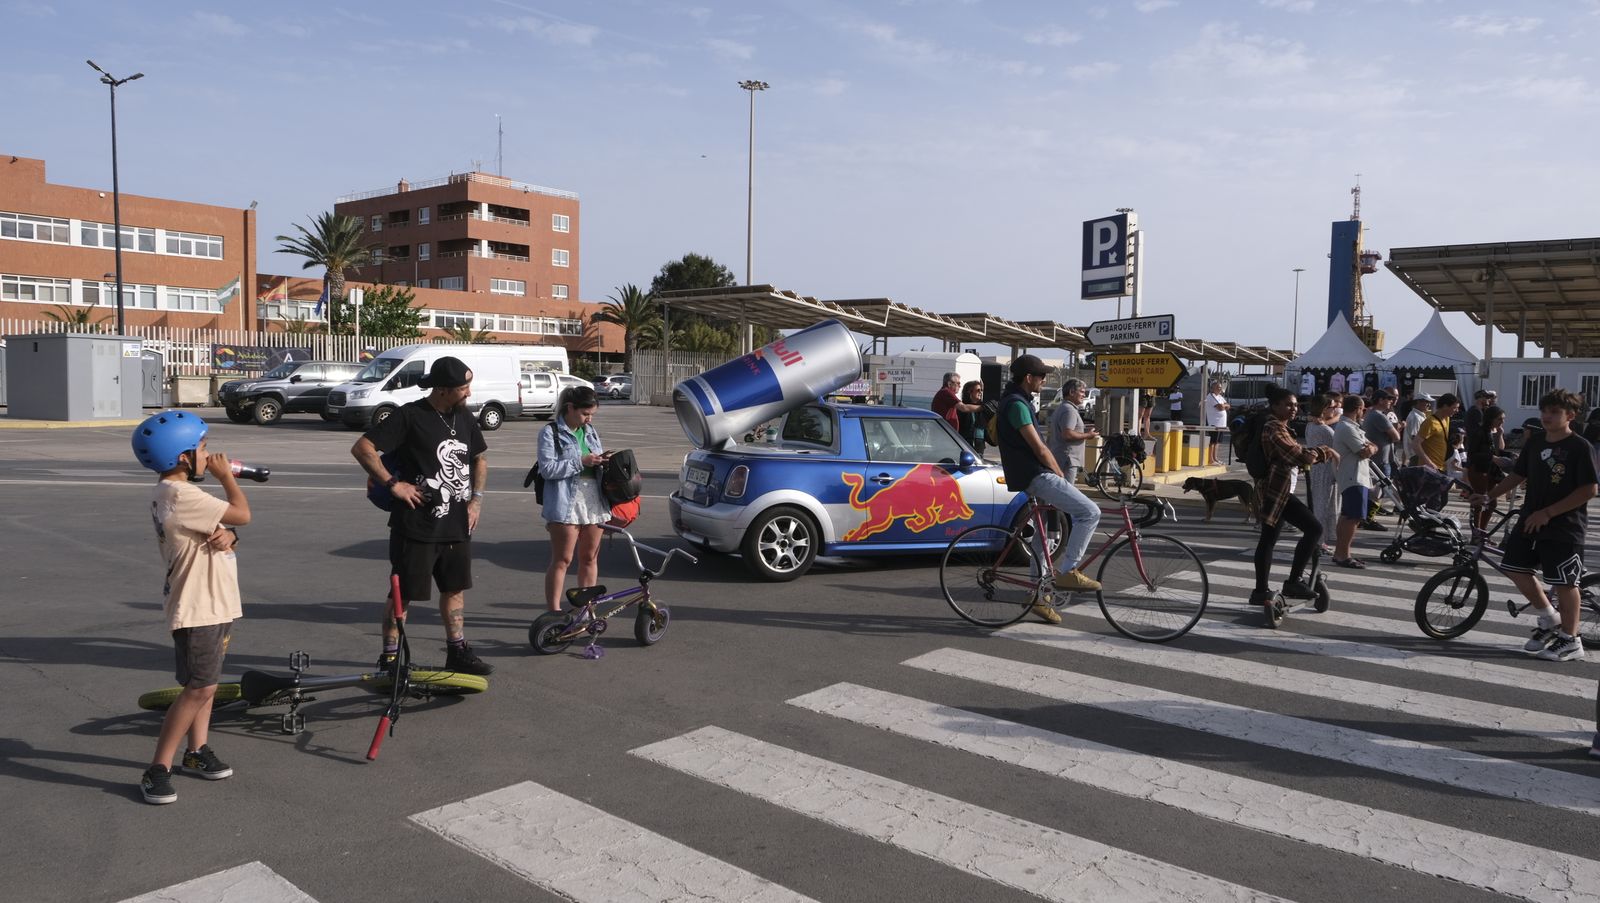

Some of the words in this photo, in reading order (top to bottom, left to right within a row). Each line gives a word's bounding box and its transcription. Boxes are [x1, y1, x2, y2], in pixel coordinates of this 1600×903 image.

[1092, 220, 1118, 266] P
[1095, 321, 1157, 333] EMBARQUE-FERRY
[1110, 331, 1140, 341] PARKING
[1109, 358, 1170, 366] EMBARQUE-FERRY
[1109, 367, 1142, 375] BOARDING
[1146, 367, 1164, 375] CARD
